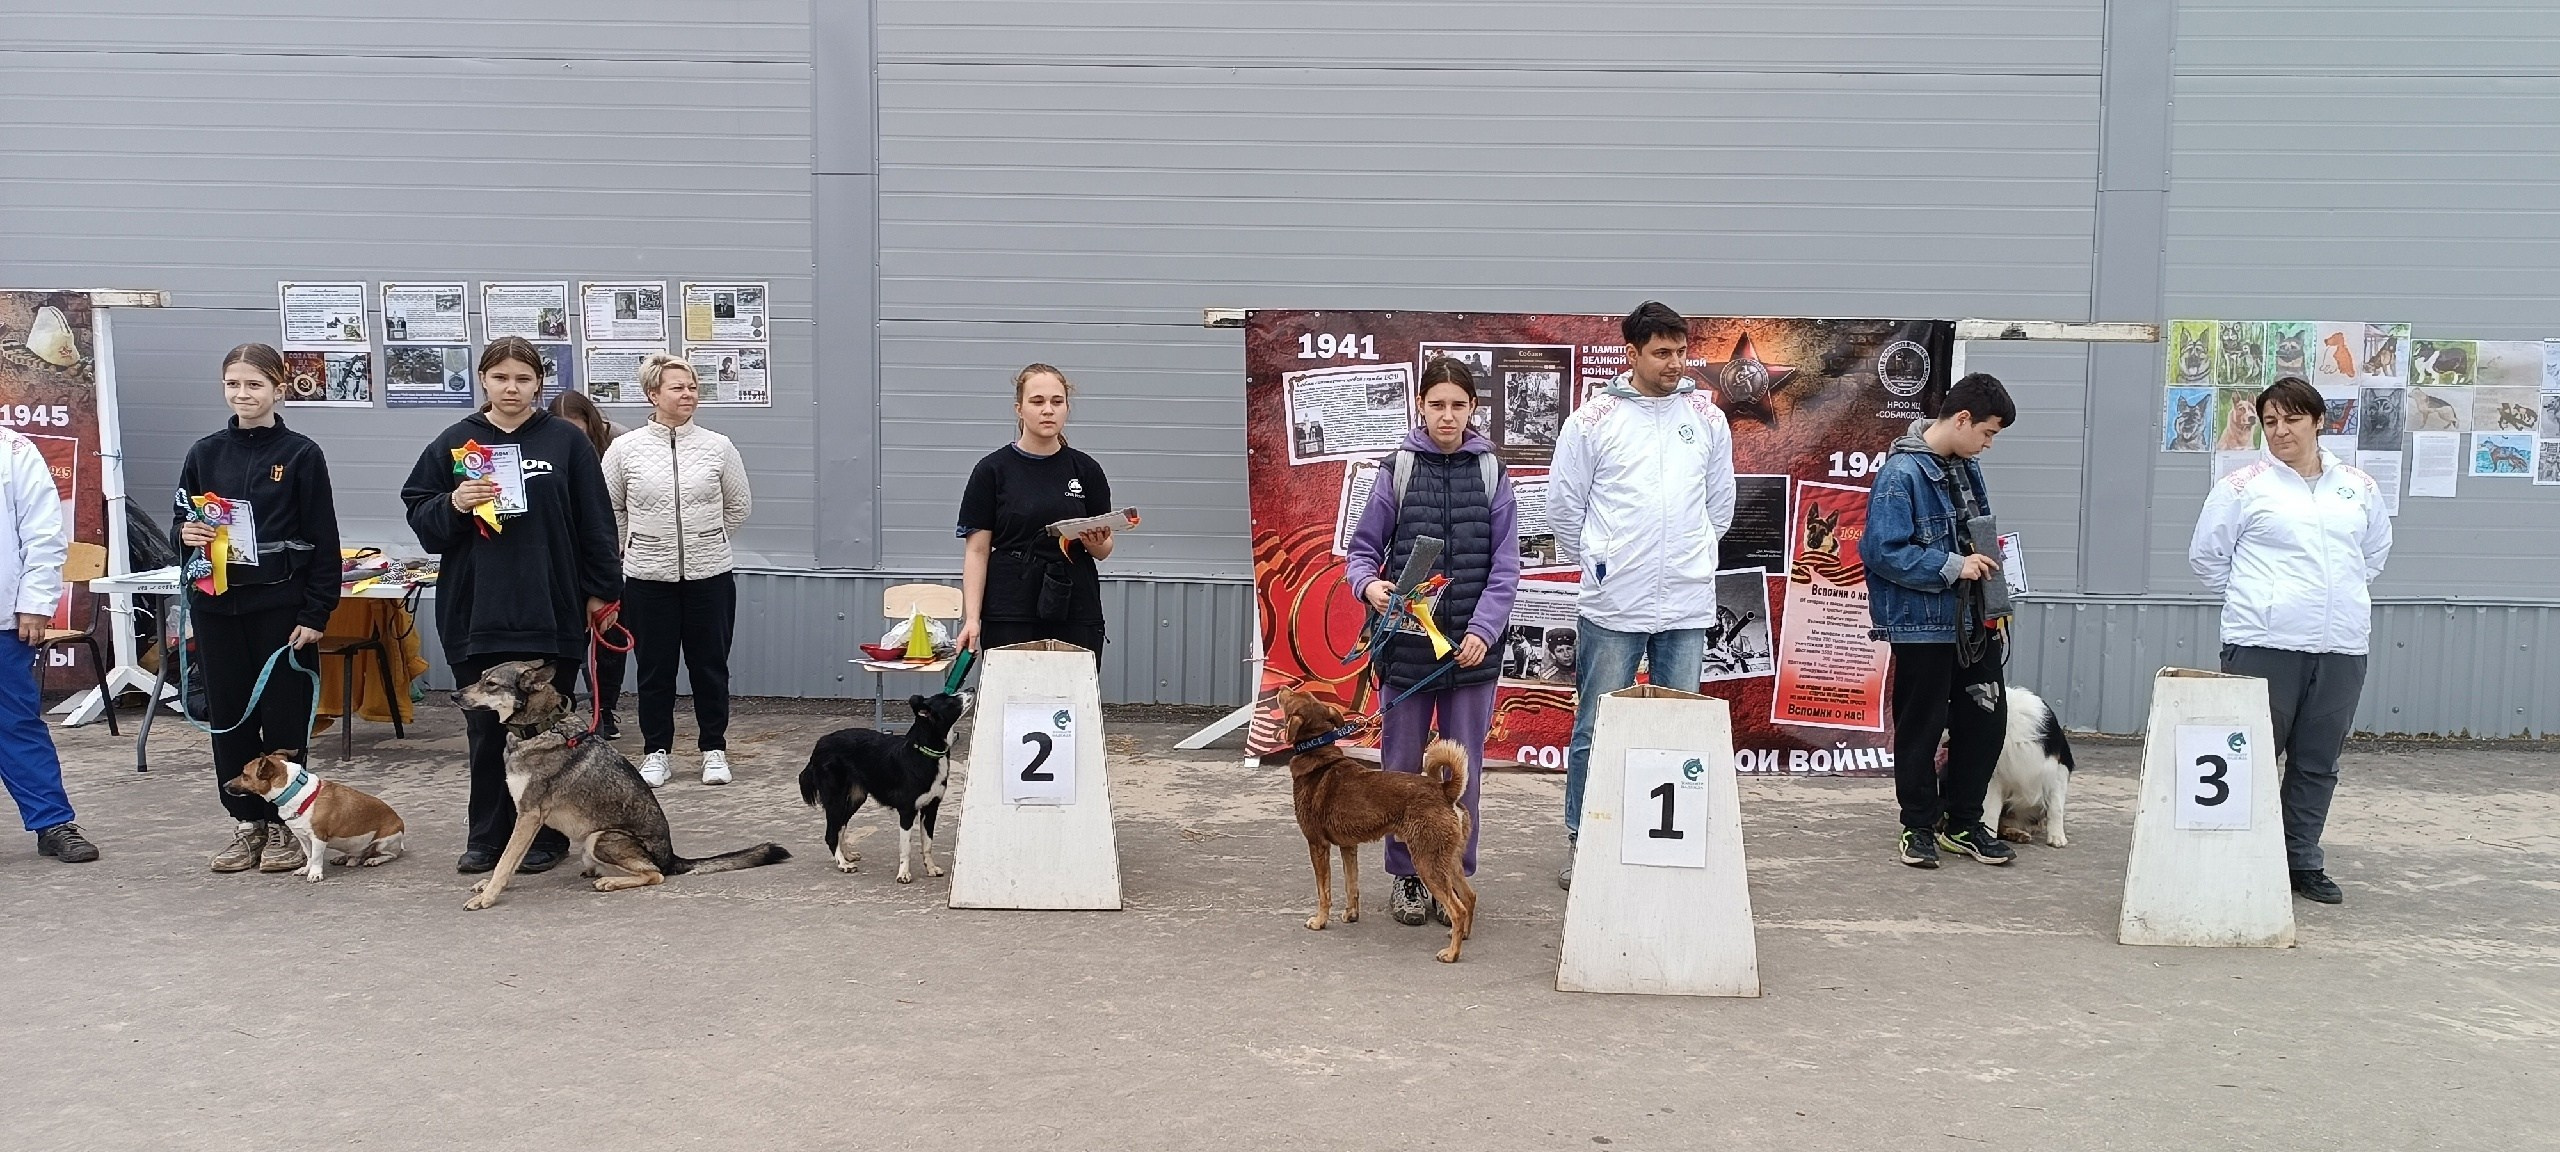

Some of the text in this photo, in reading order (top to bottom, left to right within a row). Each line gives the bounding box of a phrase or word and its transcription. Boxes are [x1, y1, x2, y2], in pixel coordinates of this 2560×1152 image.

[1298, 332, 1380, 360] 1941
[1582, 346, 1589, 354] В
[1582, 354, 1627, 365] ВЕЛИКОЙ
[1581, 365, 1618, 376] ВОЙНЫ
[0, 404, 70, 427] 1945
[49, 465, 72, 479] 945
[1828, 451, 1887, 478] 194
[1840, 526, 1863, 541] 194
[1811, 583, 1849, 599] Вспомни
[1857, 591, 1868, 601] на
[1787, 703, 1833, 718] Вспомни
[1844, 709, 1865, 721] нас!
[1021, 731, 1054, 782] 2
[2194, 754, 2230, 807] 3
[1648, 782, 1684, 840] 1
